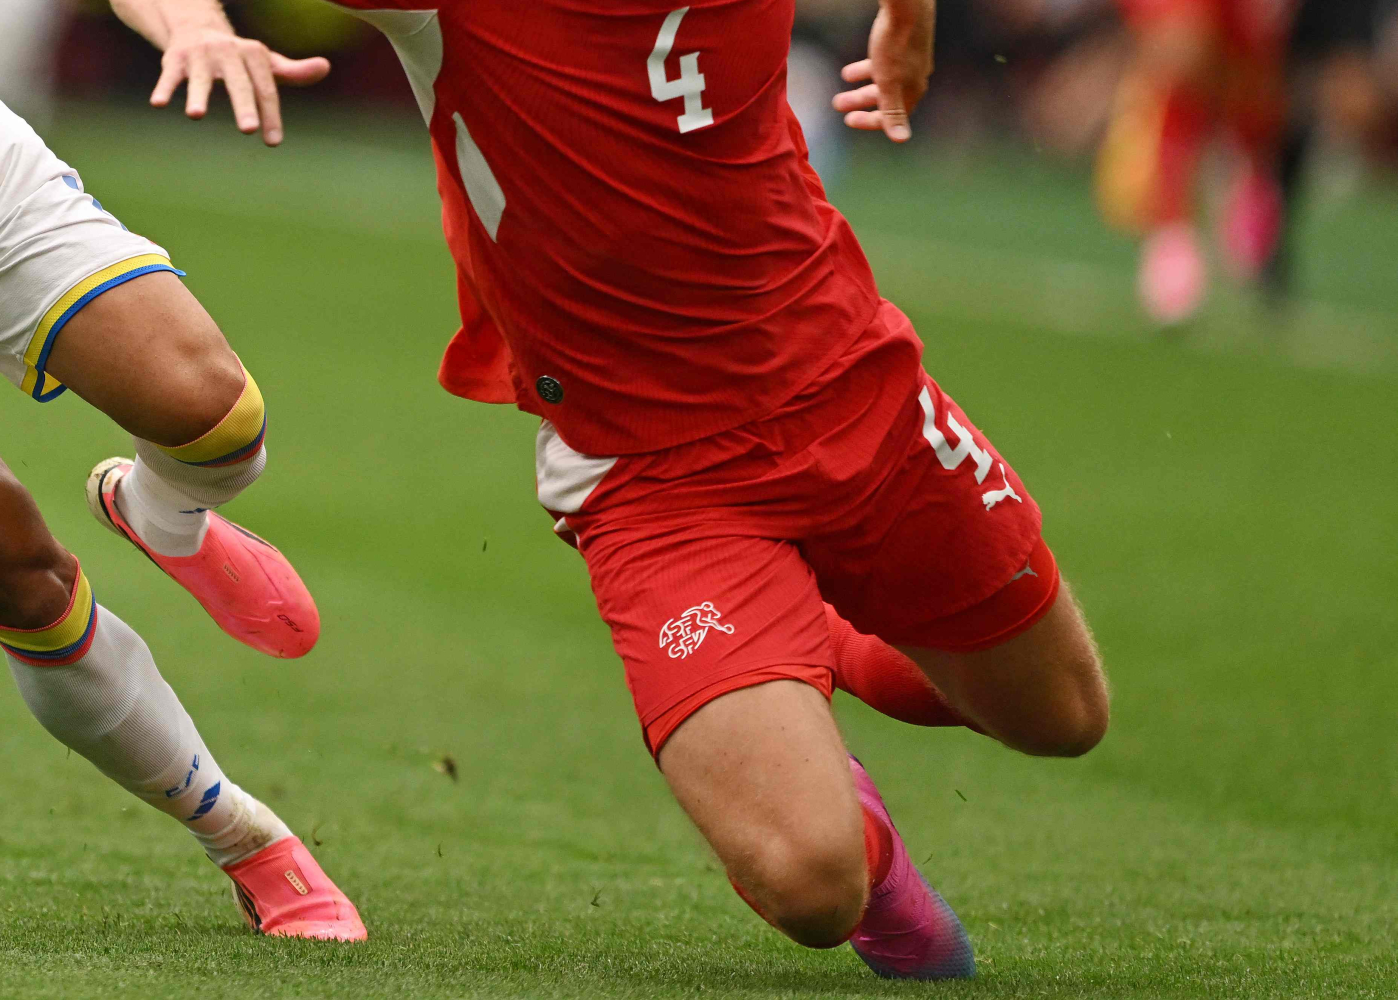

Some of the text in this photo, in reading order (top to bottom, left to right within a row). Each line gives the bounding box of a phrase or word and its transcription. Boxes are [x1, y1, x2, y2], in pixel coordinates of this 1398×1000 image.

[646, 6, 714, 133] 4
[918, 386, 993, 484] 4
[277, 614, 304, 632] F50
